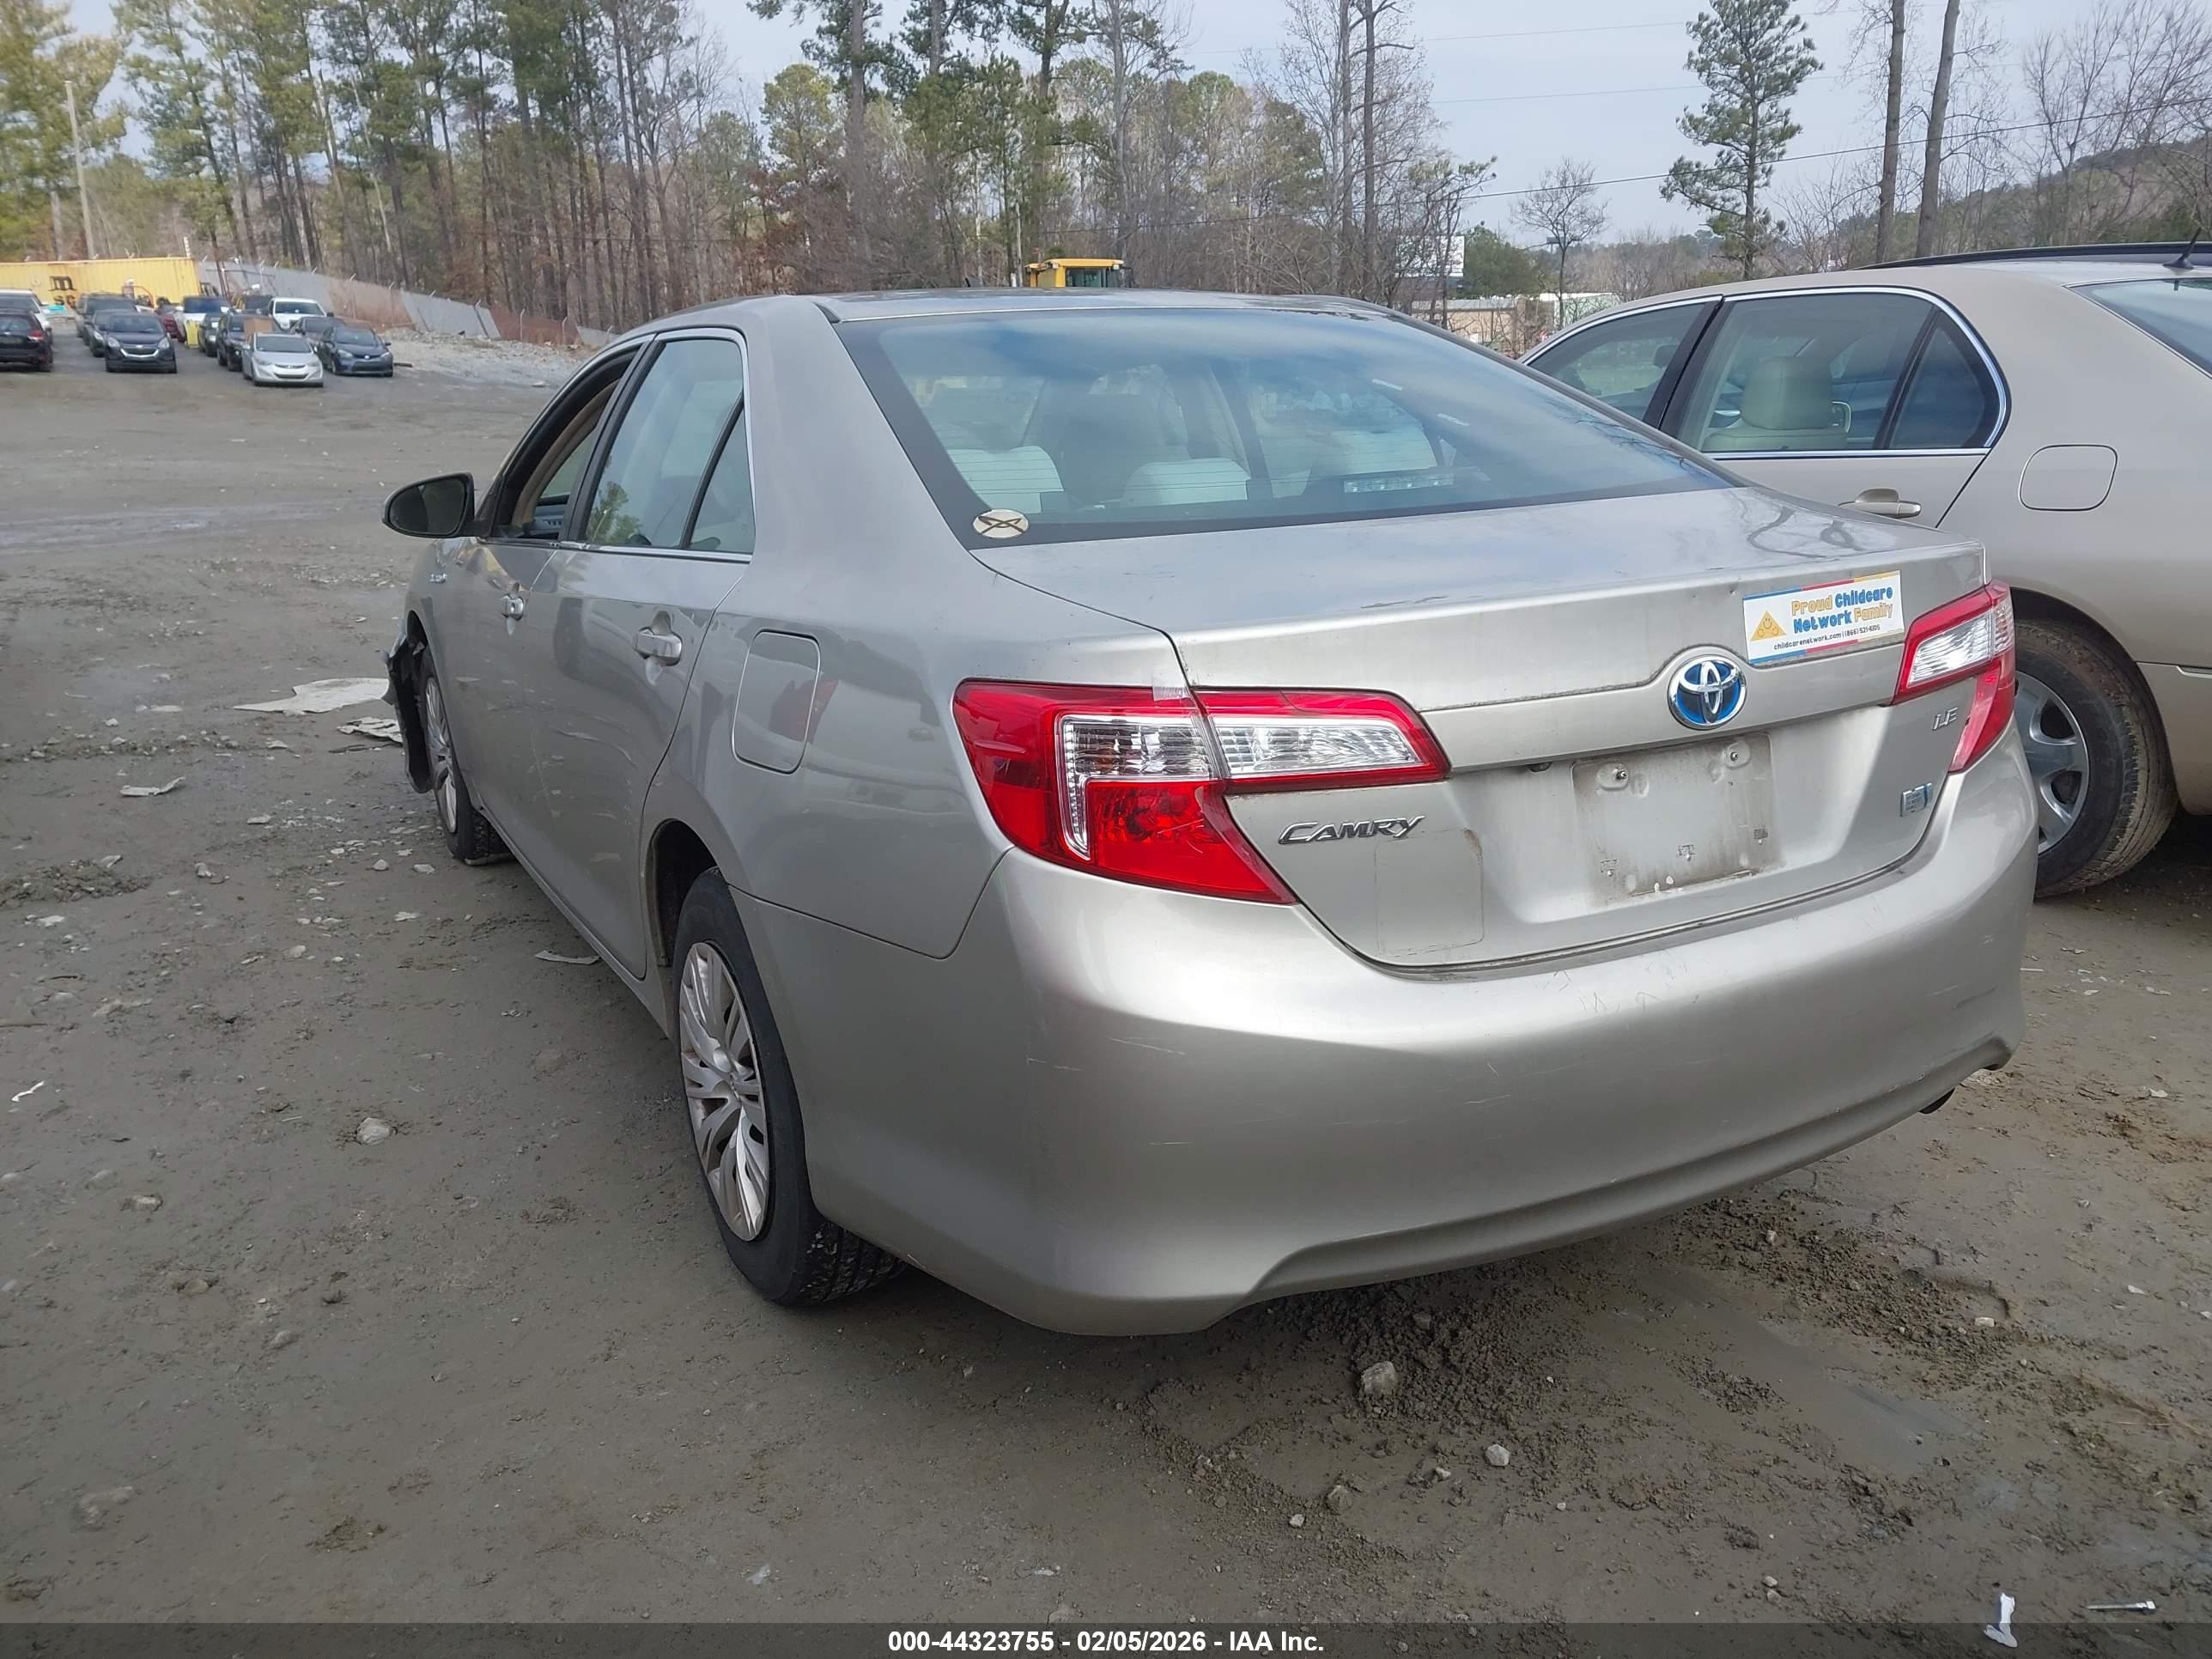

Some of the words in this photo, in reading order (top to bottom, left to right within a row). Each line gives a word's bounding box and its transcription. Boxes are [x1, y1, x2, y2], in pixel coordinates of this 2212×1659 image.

[1791, 595, 1833, 617] Proud
[1834, 586, 1893, 609] Childcare
[1793, 610, 1853, 634] Network
[1853, 603, 1893, 623] Family
[1773, 633, 1842, 650] childcarenetwork.com
[1932, 708, 1958, 730] LE
[1278, 816, 1425, 844] CAMRY
